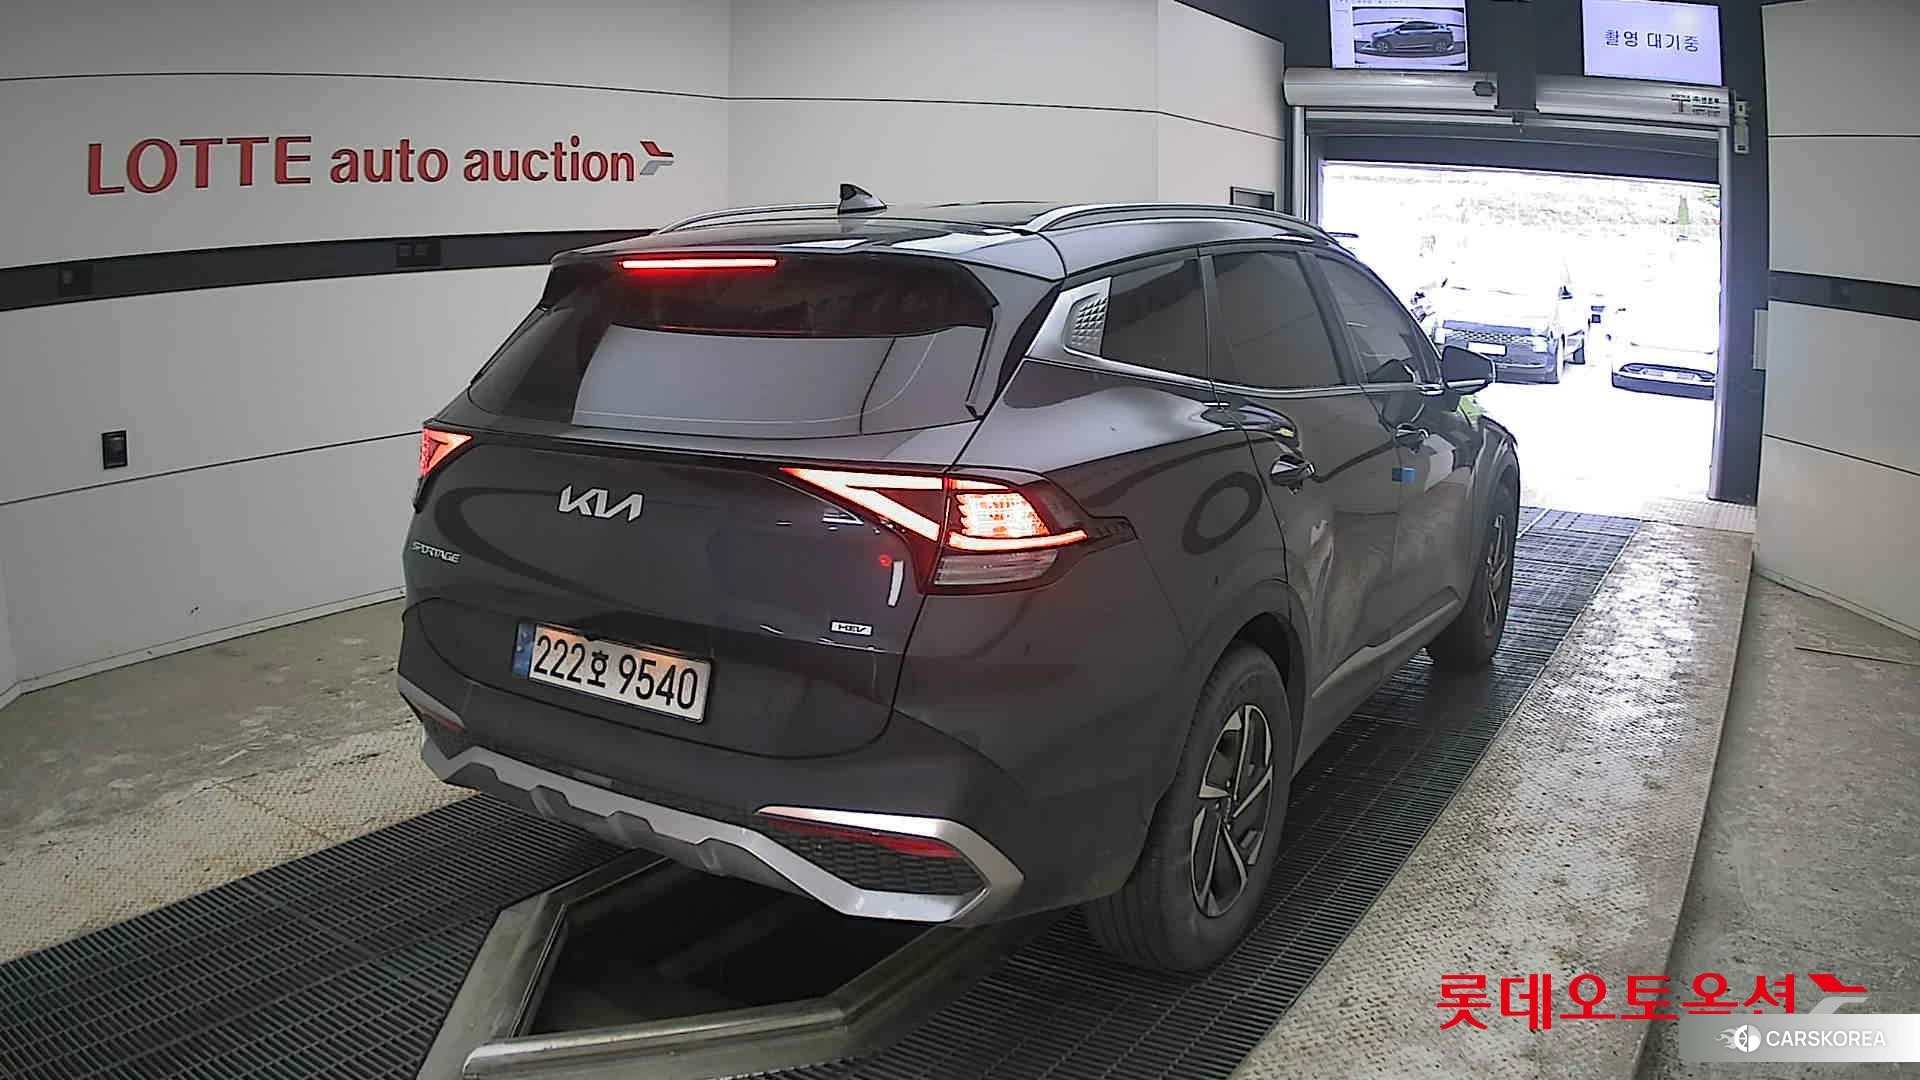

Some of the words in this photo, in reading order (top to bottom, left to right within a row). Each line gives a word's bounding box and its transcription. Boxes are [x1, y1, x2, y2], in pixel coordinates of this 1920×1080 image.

[1647, 32, 1699, 52] 대기중
[87, 136, 312, 196] LOTTE
[330, 137, 449, 184] auto
[463, 135, 636, 182] auction
[559, 485, 643, 522] KIA
[533, 635, 609, 688] 222호
[619, 654, 698, 710] 9540
